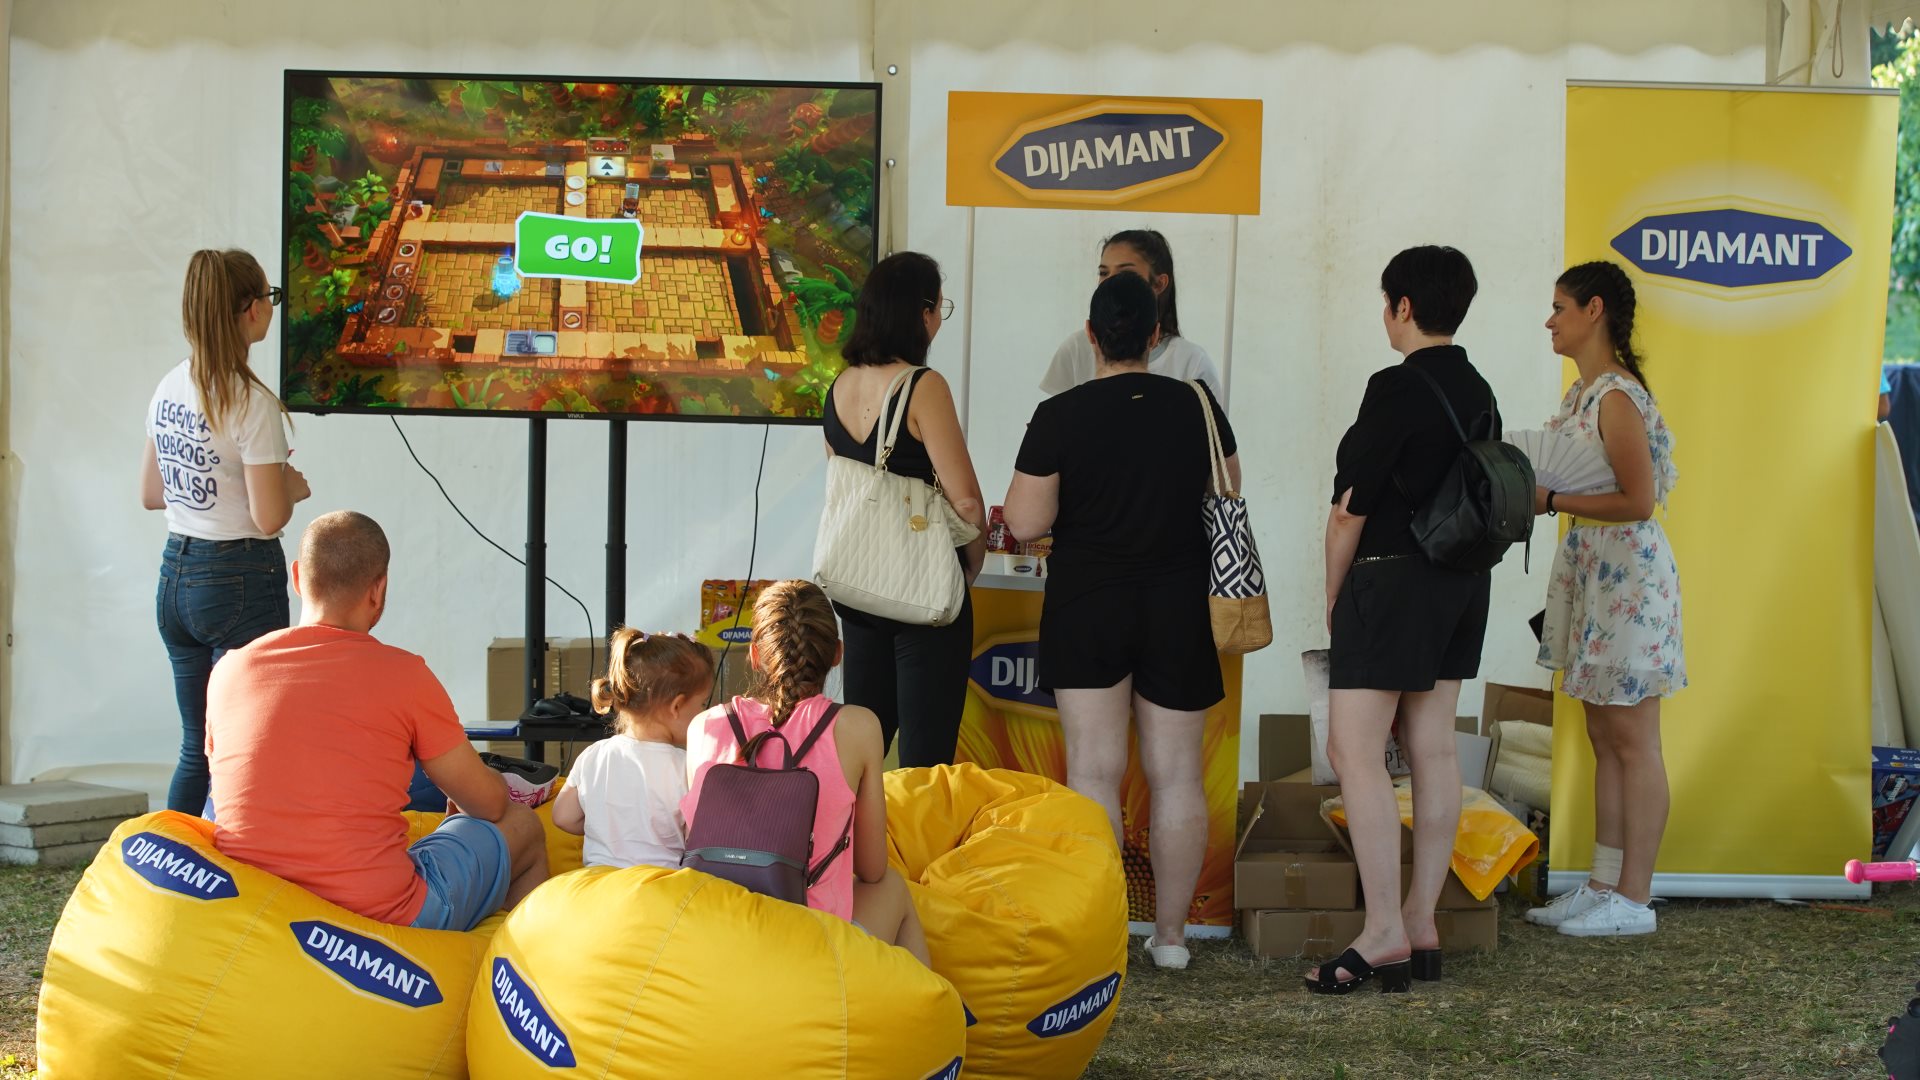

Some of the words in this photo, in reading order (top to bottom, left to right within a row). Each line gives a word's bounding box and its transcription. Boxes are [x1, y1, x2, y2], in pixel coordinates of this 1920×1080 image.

[1023, 125, 1195, 181] DIJAMANT
[544, 234, 613, 264] GO!
[1641, 228, 1824, 270] DIJAMANT
[722, 631, 753, 640] DIAMA
[991, 656, 1040, 695] DIJ
[126, 836, 228, 894] DIJAMANT
[306, 926, 431, 1000] DIJAMANT
[494, 964, 565, 1059] DIJAMANT
[1041, 977, 1118, 1032] DIJAMANT
